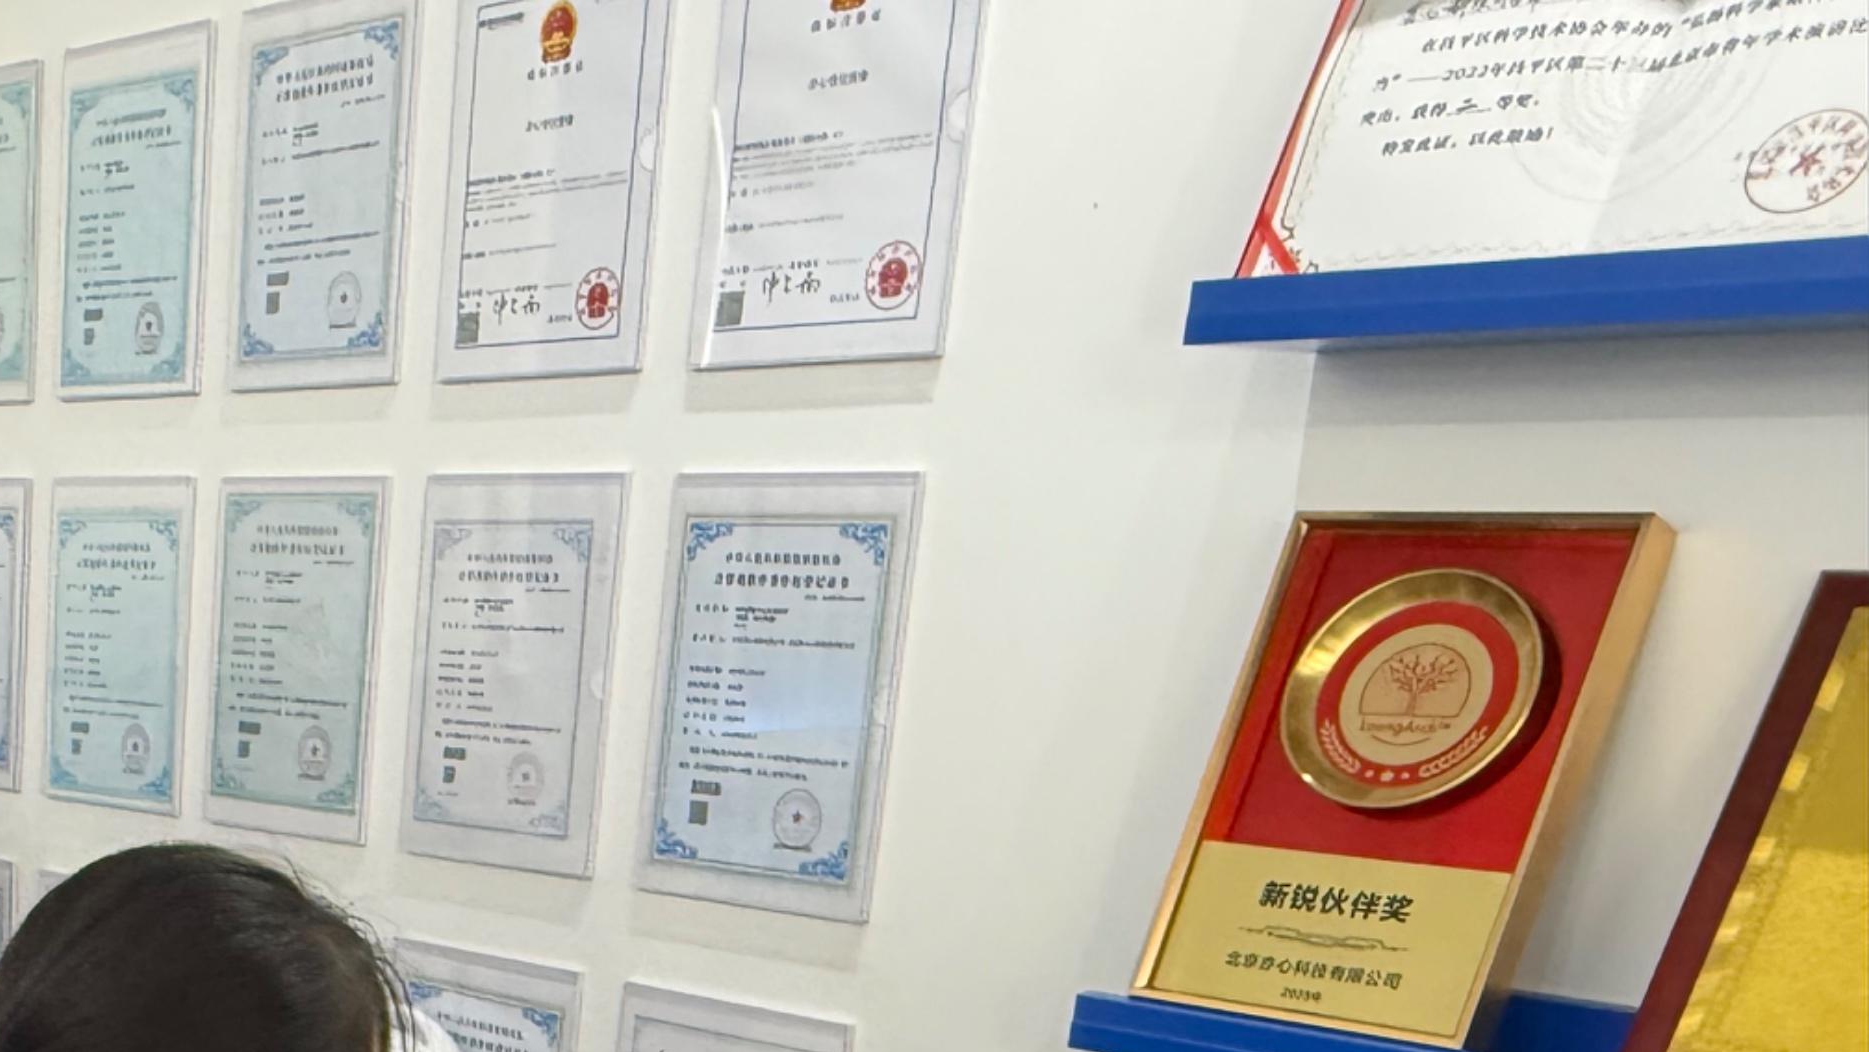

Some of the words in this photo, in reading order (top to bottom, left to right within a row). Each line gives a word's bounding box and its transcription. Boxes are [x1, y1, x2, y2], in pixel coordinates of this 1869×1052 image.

[1258, 880, 1414, 923] 新锐伙伴奖
